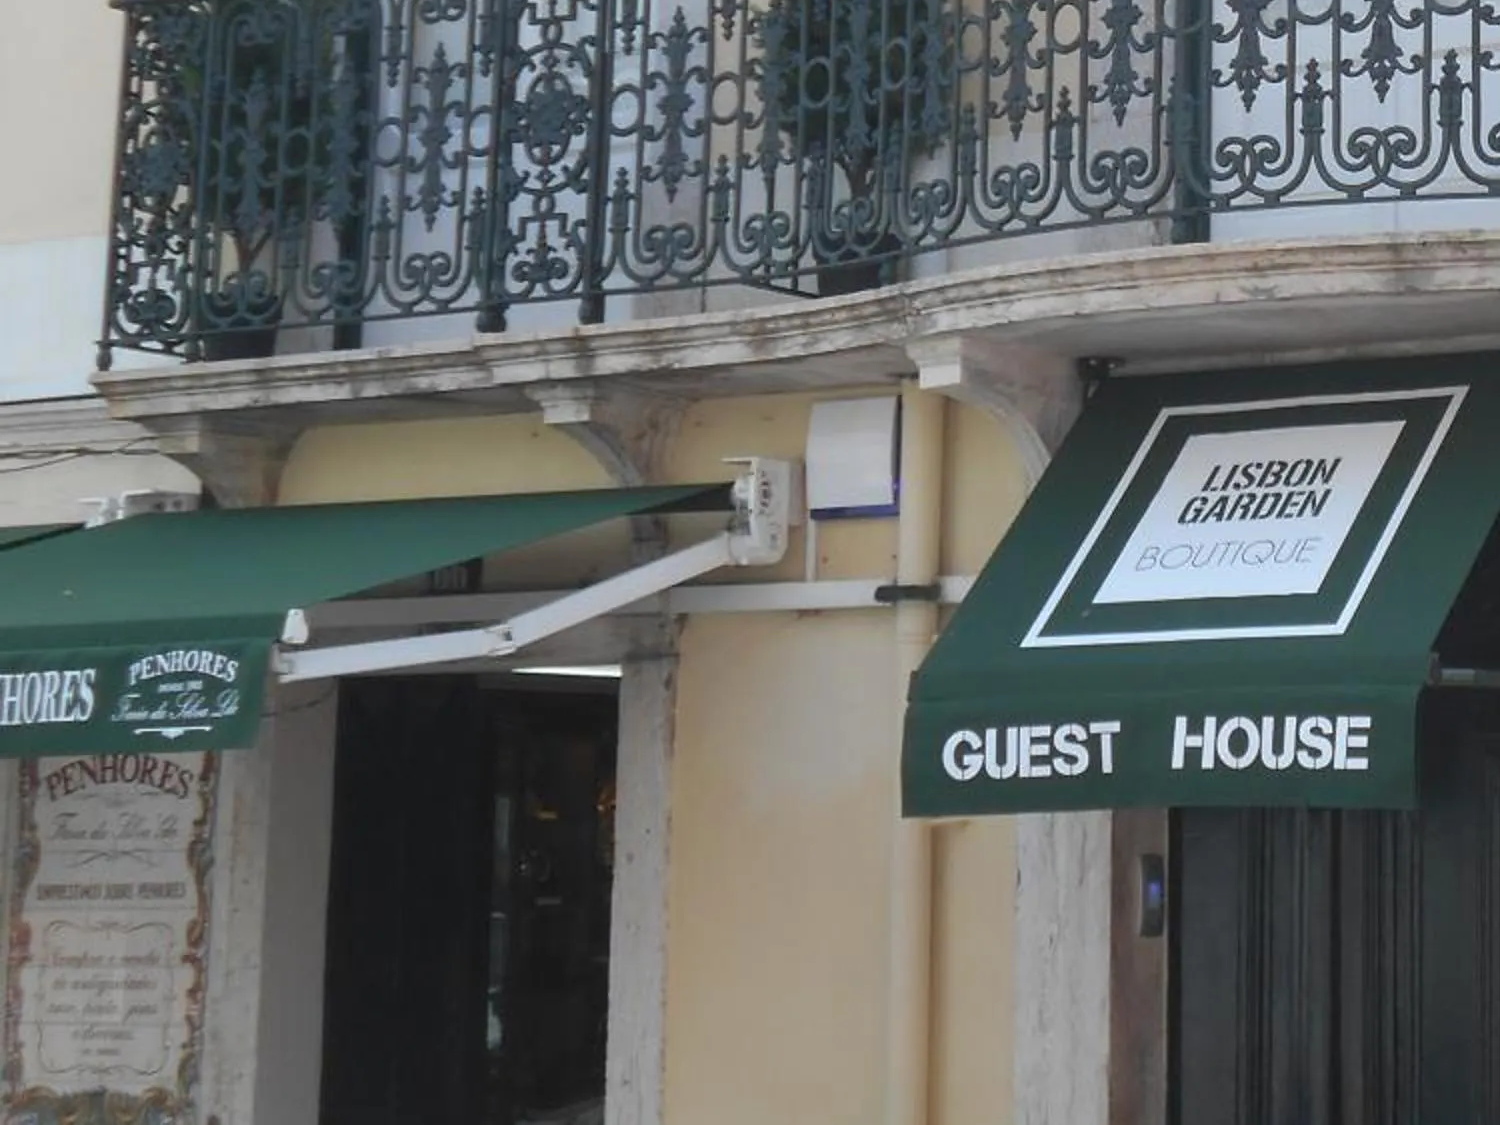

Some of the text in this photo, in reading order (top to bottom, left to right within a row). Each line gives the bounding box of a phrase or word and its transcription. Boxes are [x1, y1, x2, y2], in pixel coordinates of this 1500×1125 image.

[1201, 456, 1342, 493] LISBON
[1177, 489, 1331, 526] GARDEN
[1135, 536, 1322, 573] BOUTIQUE
[129, 650, 239, 686] PENHORES
[942, 715, 1372, 781] GUEST HOUSE
[46, 751, 195, 802] PENHORES
